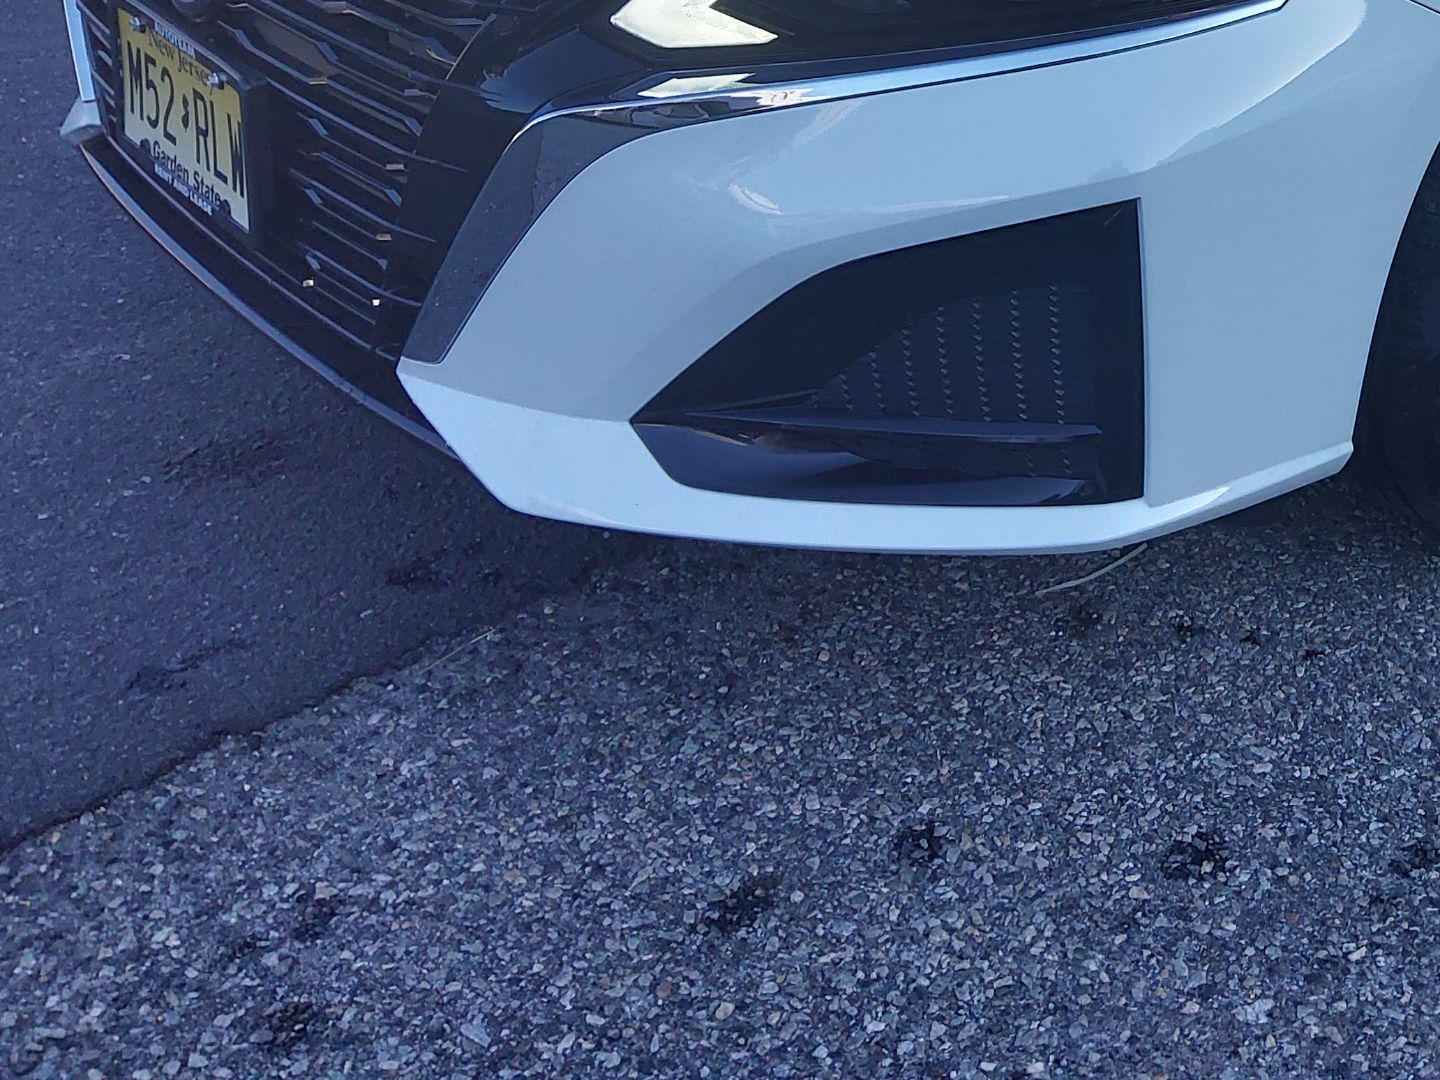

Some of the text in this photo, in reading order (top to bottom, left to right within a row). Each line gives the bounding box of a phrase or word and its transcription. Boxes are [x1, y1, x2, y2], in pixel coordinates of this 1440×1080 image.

[149, 31, 175, 62] New
[153, 140, 221, 206] Garden State
